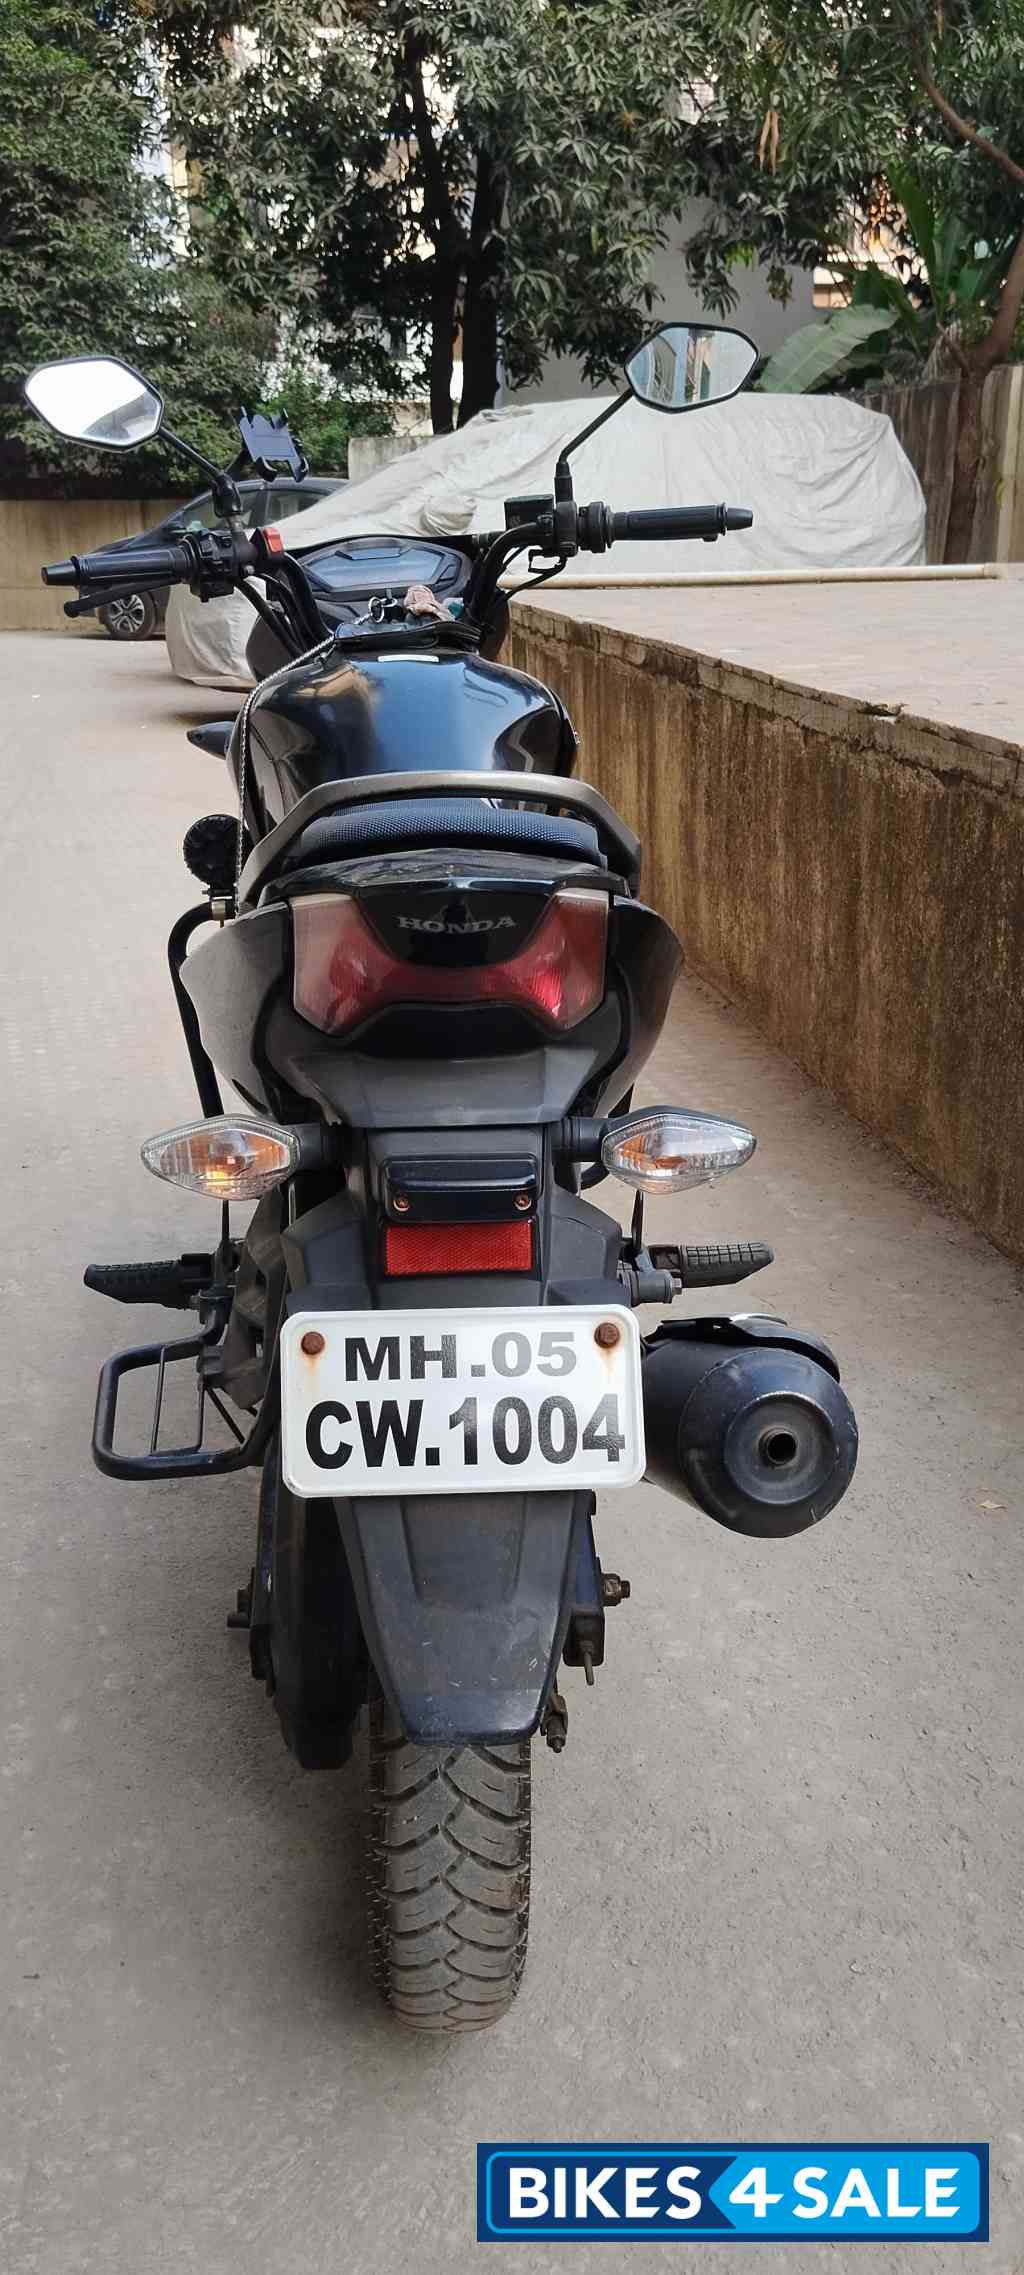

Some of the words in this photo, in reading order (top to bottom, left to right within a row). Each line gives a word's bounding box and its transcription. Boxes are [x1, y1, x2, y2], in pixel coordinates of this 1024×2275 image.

[396, 914, 518, 934] HONDA
[343, 1331, 578, 1382] MH.05
[304, 1393, 626, 1470] CW.1004
